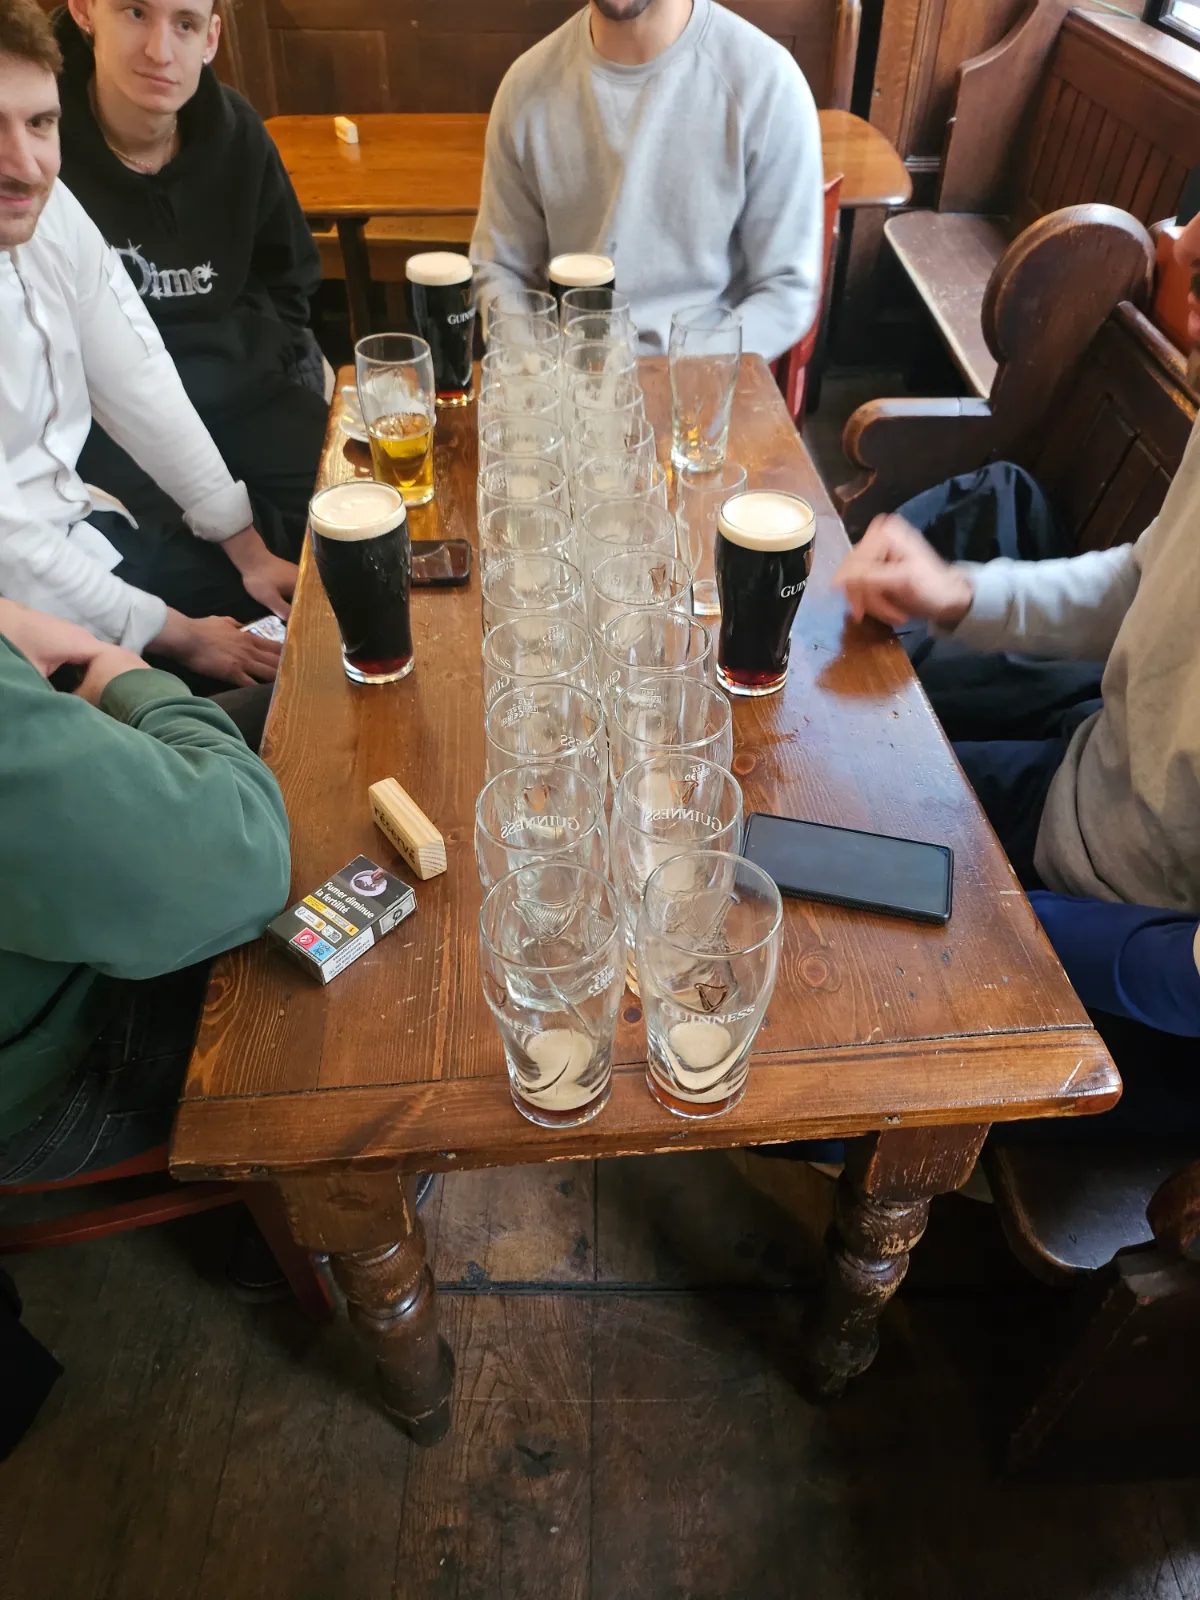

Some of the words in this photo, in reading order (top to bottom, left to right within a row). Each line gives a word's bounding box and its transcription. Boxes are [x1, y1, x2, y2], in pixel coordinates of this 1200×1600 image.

[110, 243, 216, 299] Dime
[314, 888, 323, 897] la
[321, 893, 351, 914] fertilité
[324, 881, 347, 899] Fumer
[345, 894, 375, 919] diminue
[660, 1002, 756, 1025] GUINNESS
